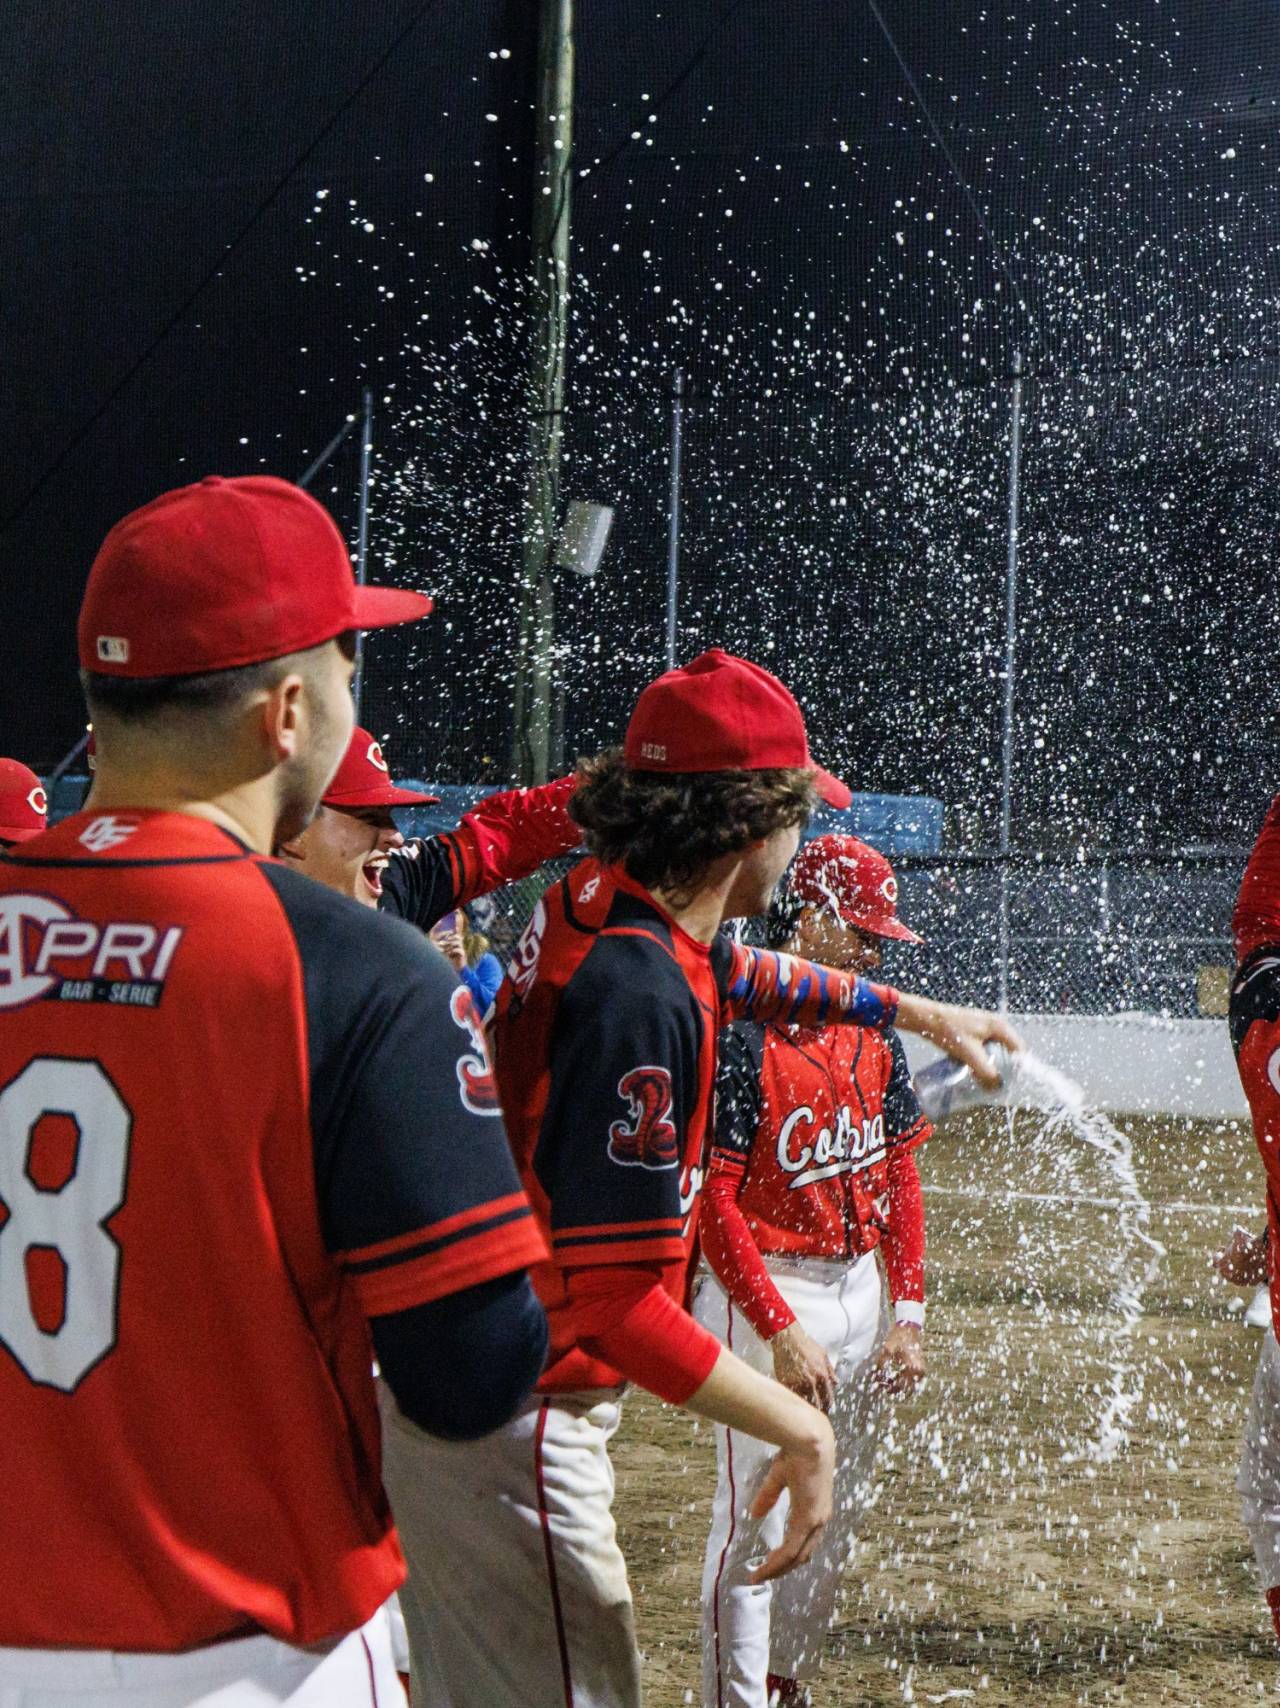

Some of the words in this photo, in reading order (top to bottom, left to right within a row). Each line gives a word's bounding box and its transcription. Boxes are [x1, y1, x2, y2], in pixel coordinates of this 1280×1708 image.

[366, 742, 389, 772] C
[27, 787, 48, 815] C
[60, 980, 94, 1001] BAR
[108, 982, 160, 1007] SERIE
[0, 1055, 135, 1394] 8
